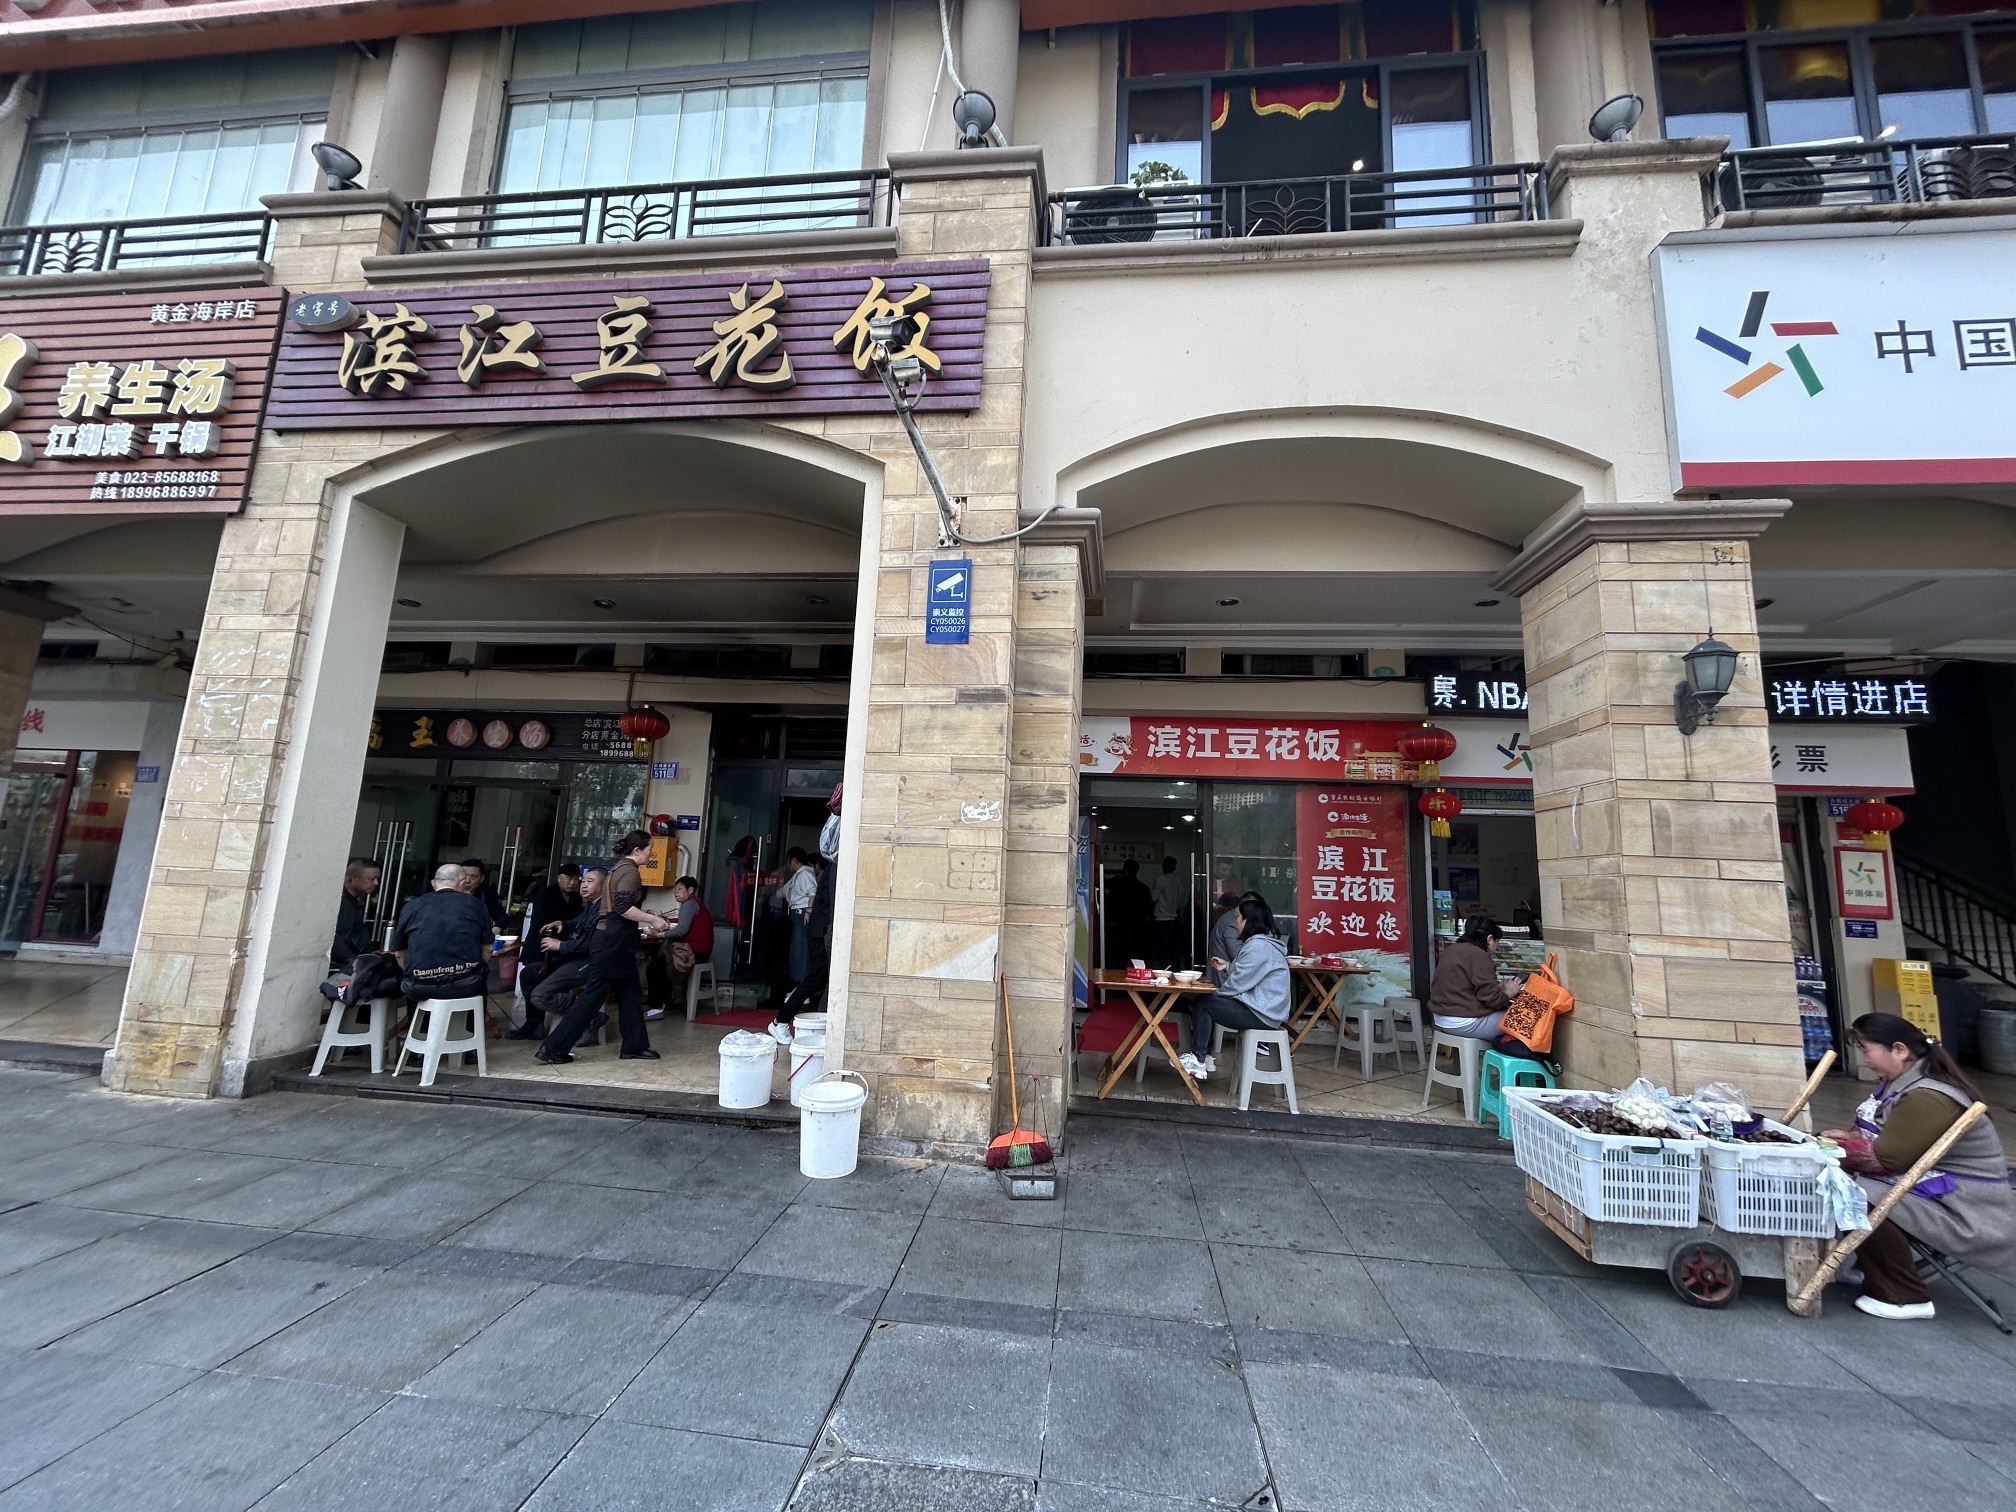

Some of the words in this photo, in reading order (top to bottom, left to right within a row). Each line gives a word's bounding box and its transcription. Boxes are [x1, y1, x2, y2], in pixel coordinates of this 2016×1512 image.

[151, 301, 256, 323] 黄金海岸店
[295, 300, 339, 317] 老字号
[338, 275, 942, 396] 滨江豆花饭
[1873, 317, 2016, 374] 中国
[57, 358, 230, 419] 养生汤
[44, 422, 135, 457] 江湖菜
[148, 420, 212, 454] 干锅
[94, 471, 121, 484] 美食
[123, 470, 219, 484] 023-85688168
[120, 485, 217, 499] 18996886997
[930, 617, 966, 625] CY050026
[1770, 680, 1930, 716] 详情进店
[1147, 725, 1341, 762] 滨江豆花饭
[1311, 876, 1396, 904] 豆花饭
[1845, 889, 1885, 898] 中国体彩
[1306, 911, 1401, 941] 欢迎您
